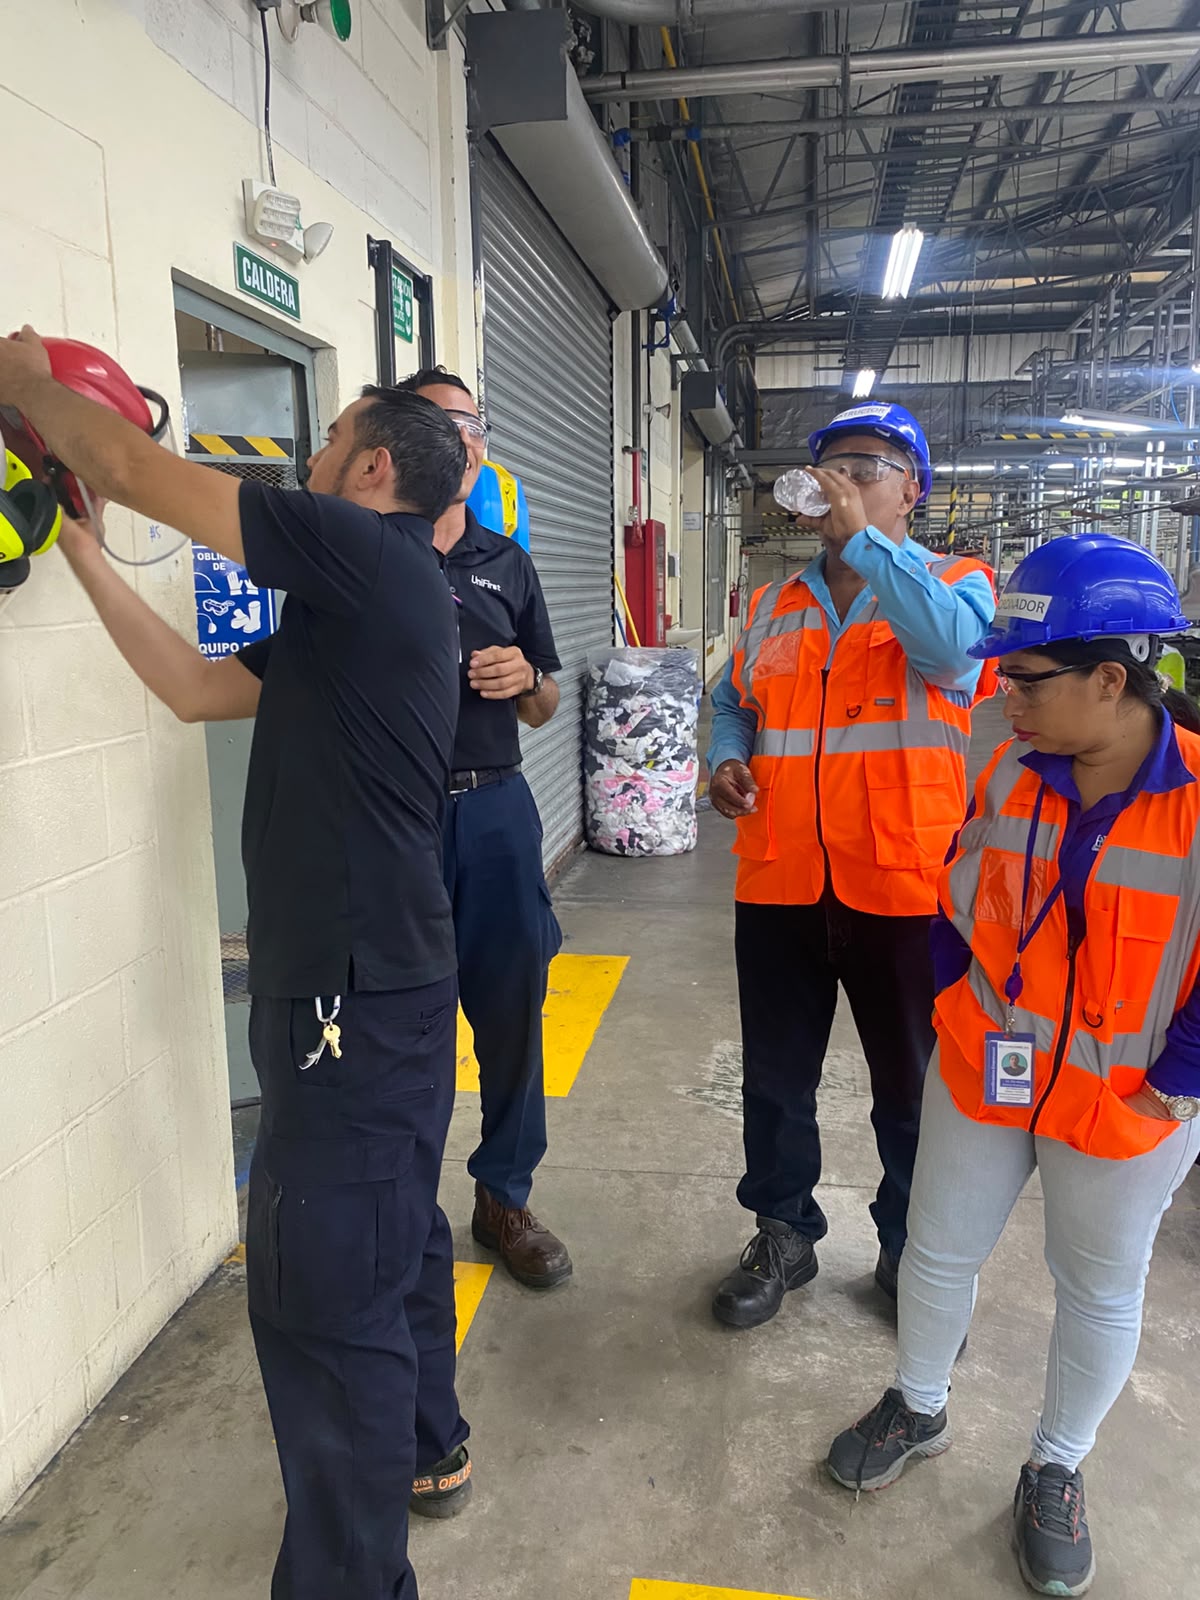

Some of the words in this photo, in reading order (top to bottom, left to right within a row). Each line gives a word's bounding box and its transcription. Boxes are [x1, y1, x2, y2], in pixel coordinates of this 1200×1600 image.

[243, 256, 297, 311] CALDERA
[212, 562, 226, 571] DE
[471, 575, 501, 591] UniFirst
